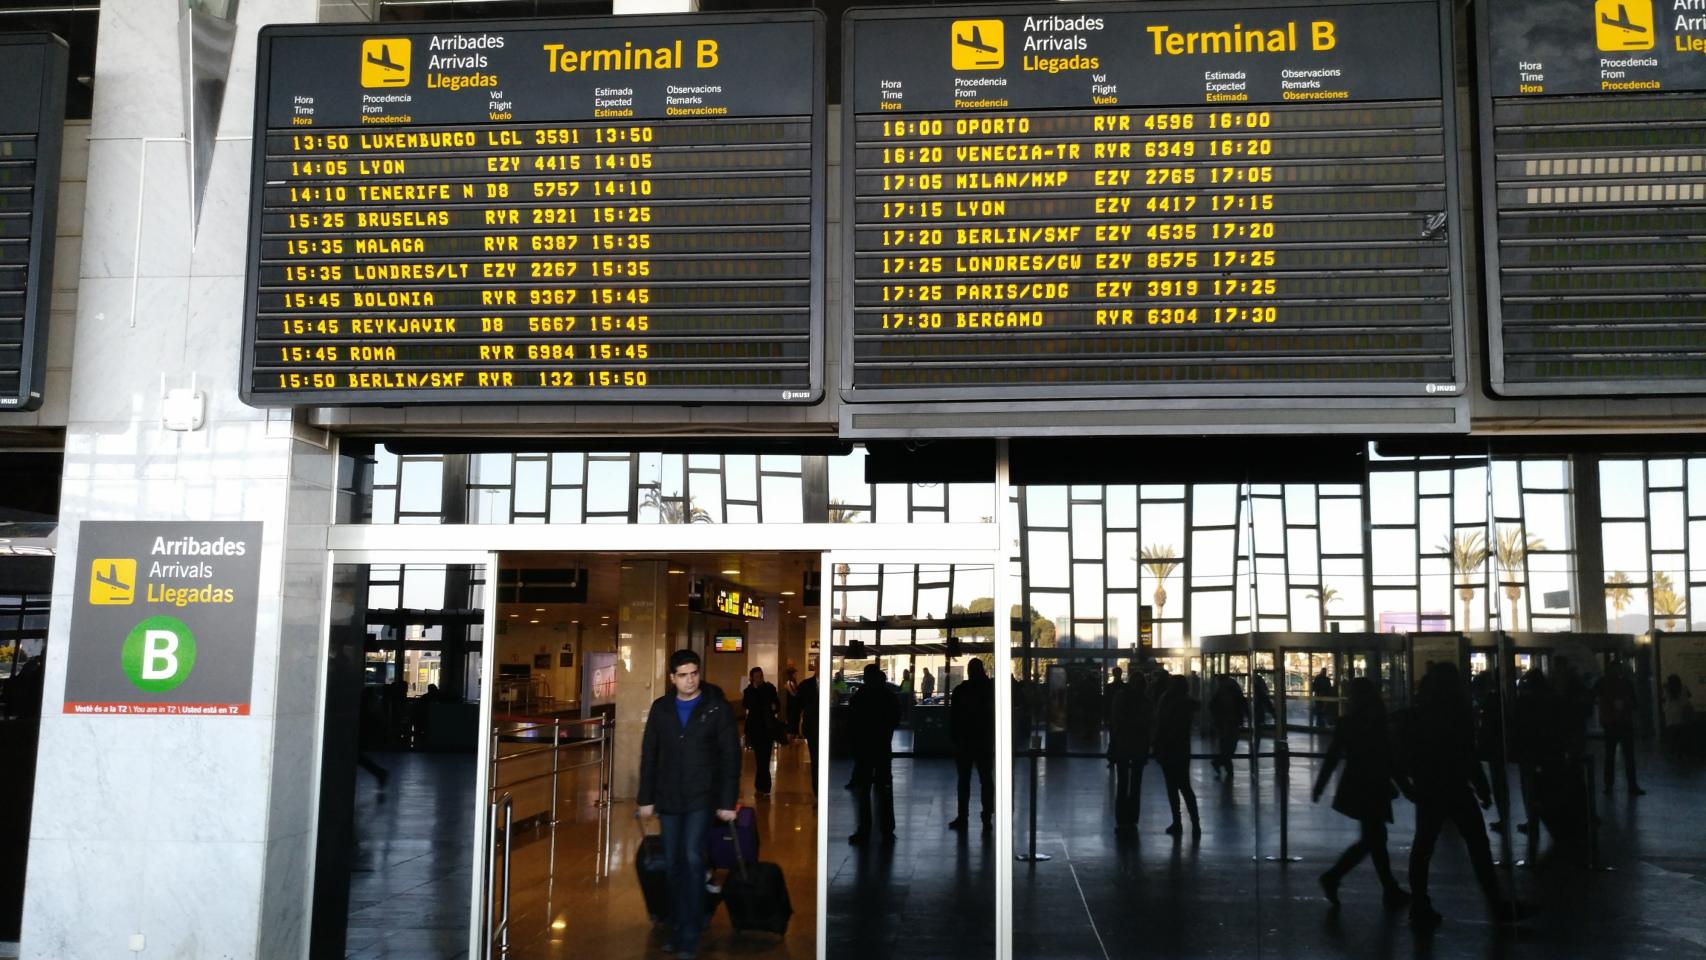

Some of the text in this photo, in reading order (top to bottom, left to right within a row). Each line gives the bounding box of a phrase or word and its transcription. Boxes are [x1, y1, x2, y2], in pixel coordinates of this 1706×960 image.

[1023, 15, 1105, 32] Arribades
[430, 34, 505, 51] Arribades
[1023, 34, 1088, 52] Arrivals
[1145, 21, 1337, 55] Terminal B
[429, 53, 488, 70] Arrivals
[543, 39, 719, 73] Terminal B
[1023, 53, 1100, 74] Llegadas
[1519, 61, 1543, 71] Hora
[1600, 57, 1658, 68] Procedencia
[1092, 73, 1107, 83] Vol
[1205, 71, 1247, 80] Estimada
[1281, 68, 1341, 78] Observacions
[1519, 72, 1544, 81] Time
[1601, 69, 1626, 79] From
[427, 71, 498, 92] Llegadas
[881, 80, 902, 89] Hora
[954, 77, 1008, 87] Procedencia
[1205, 81, 1246, 93] Expected
[1281, 79, 1321, 89] Remarks
[1601, 80, 1661, 91] Procedencia
[594, 87, 634, 97] Estimada
[666, 84, 722, 94] Observacions
[954, 88, 977, 98] From
[1092, 84, 1117, 96] Flight
[1519, 83, 1544, 93] Hora
[294, 95, 314, 105] Hora
[362, 93, 412, 104] Procedencia
[489, 91, 504, 99] Vol
[666, 95, 703, 105] Remarks
[881, 90, 903, 100] Time
[1092, 95, 1118, 105] Vuelo
[1205, 92, 1249, 103] Estimada
[1282, 90, 1349, 101] Observaciones
[489, 101, 513, 114] Flight
[594, 98, 632, 111] Expected
[881, 101, 902, 111] Hora
[954, 98, 1009, 108] Procedencia
[294, 106, 315, 115] Time
[362, 105, 383, 114] From
[594, 108, 634, 118] Estimada
[666, 106, 728, 116] Observaciones
[293, 116, 313, 126] Hora
[361, 114, 412, 124] Procedencia
[489, 111, 513, 121] Vuelo
[883, 111, 1271, 137] 16:00 OPORTO RYR 4596 16:00
[293, 126, 653, 151] 13:50 LUXEMBURGO LGL 3591 13:50
[883, 139, 1272, 164] 16:20 VENECIA-TR RYR 6349 16:20
[292, 153, 653, 177] 14:05 LYON EZY 4415 14:05
[883, 166, 1273, 191] 17:05 MILAN/MXP EZY 2765 17:05
[290, 179, 652, 202] 14:10 TENERIFE N D8 5757 14:10
[883, 194, 1274, 219] 17:15 LYON EZY 4417 17:15
[288, 206, 651, 229] 15:25 BRUSELAS RYR 2921 15:25
[883, 222, 1275, 246] 17:20 BERLIN/SXF EZY 4535 17:20
[287, 233, 651, 255] 15:35 MALAGA RYR 6387 15:35
[883, 250, 1276, 274] 17:25 LONDRES/GW EZY 8575 17:25
[286, 260, 650, 281] 15:35 LONDRES/LT EZY 2267 15:35
[883, 278, 1277, 302] 17:25 PARIS/CDG EZY 3919 17:25
[284, 288, 650, 308] 15:45 BOLONIA RYR 9367 15:45
[882, 306, 1277, 329] 17:30 BERGAMO RYR 6304 17:30
[283, 315, 649, 335] 15:45 REYKJAVIK D8 5667 15:45
[281, 343, 648, 362] 15:45 ROMA RYR 6984 15:45
[279, 371, 647, 389] 15:50 BERLIN/SXF RYR 132 15:50
[151, 536, 246, 557] Arribades
[149, 561, 213, 579] Arrivals
[146, 583, 234, 608] Llegadas
[142, 630, 179, 680] B
[118, 705, 127, 713] T2
[133, 705, 145, 713] You
[166, 705, 176, 714] T2
[182, 706, 202, 714] Usted
[228, 706, 239, 715] T2
